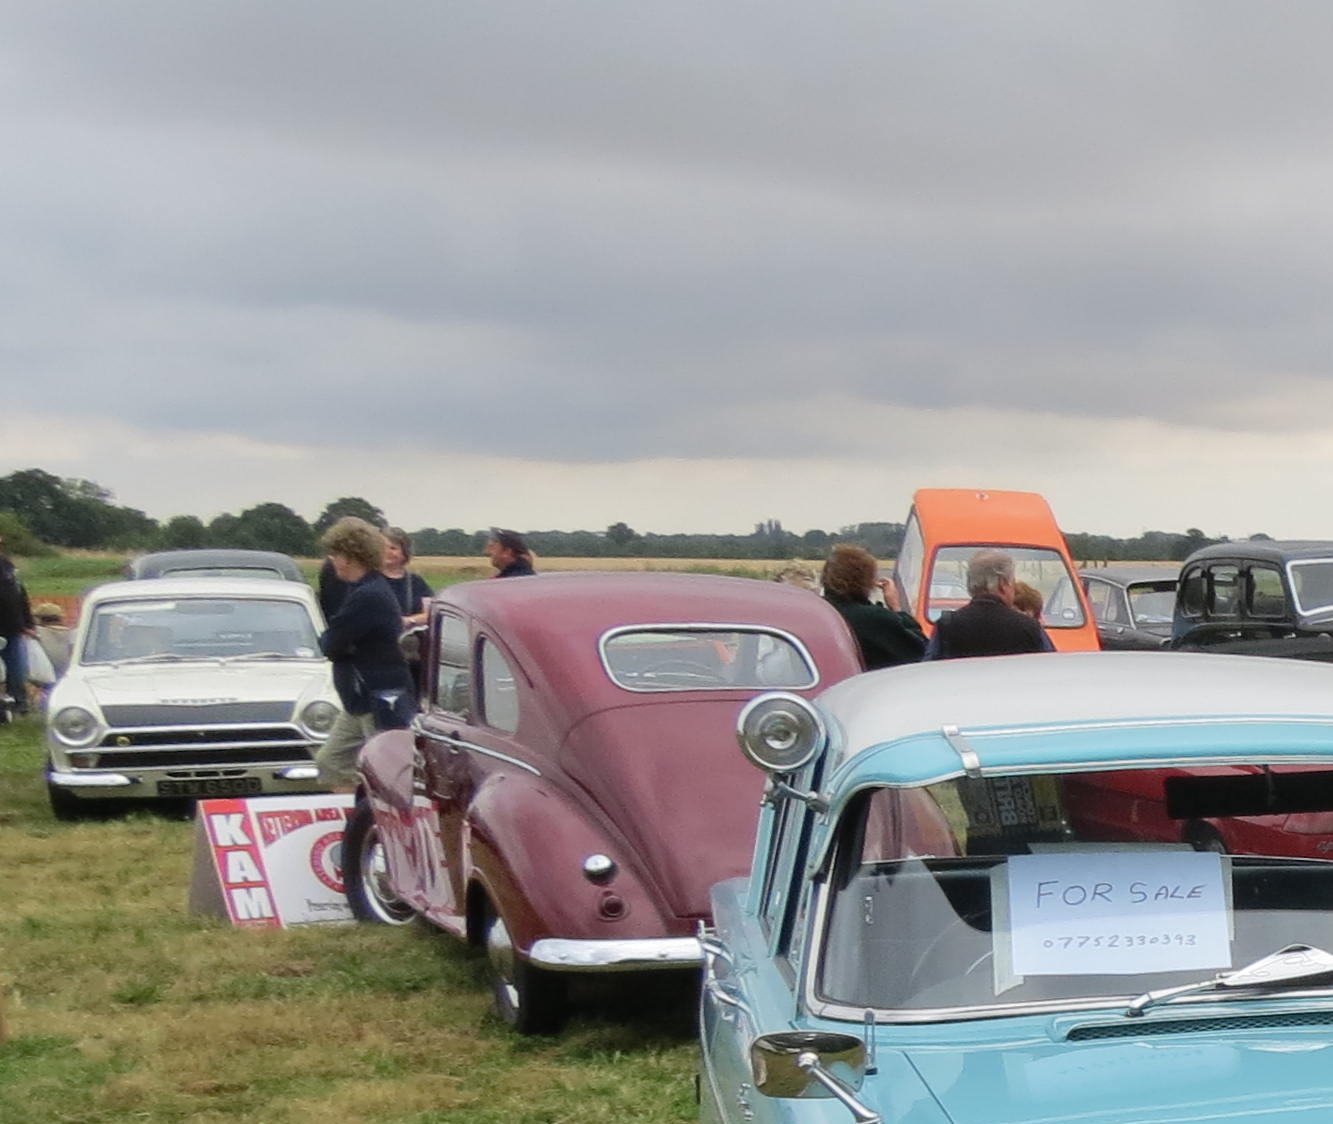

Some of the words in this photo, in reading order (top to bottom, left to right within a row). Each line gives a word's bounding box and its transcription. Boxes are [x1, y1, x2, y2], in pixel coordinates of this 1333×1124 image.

[211, 812, 274, 920] KAM
[1036, 880, 1113, 909] FOR
[1129, 881, 1207, 904] SALE
